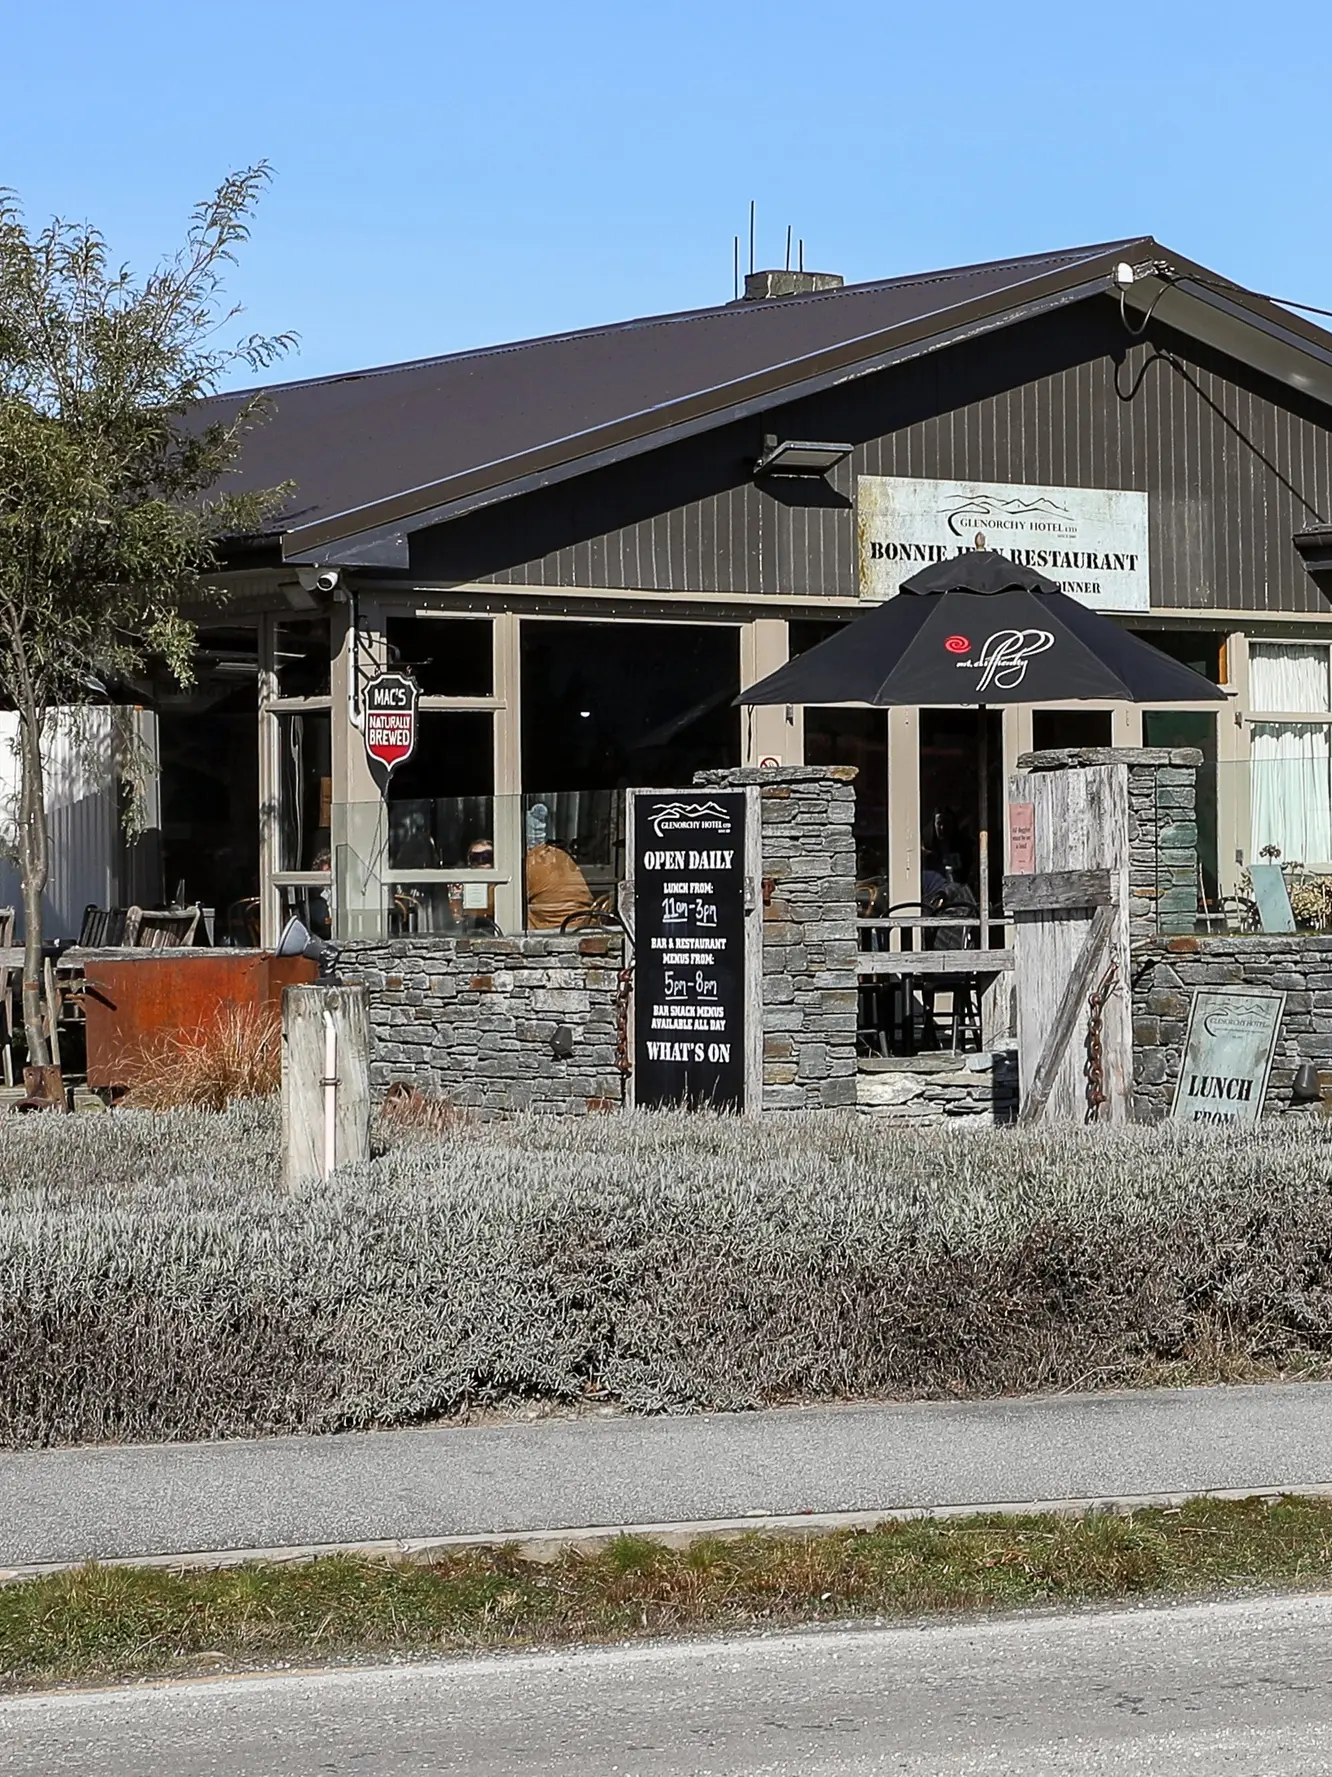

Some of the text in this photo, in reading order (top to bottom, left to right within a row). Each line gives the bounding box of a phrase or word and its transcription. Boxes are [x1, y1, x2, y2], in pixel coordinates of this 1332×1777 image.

[960, 517, 1026, 531] GLENORCHY
[1029, 521, 1065, 533] HOTEL
[870, 540, 948, 563] BONNIE
[1010, 547, 1139, 572] RESTAURANT
[373, 688, 407, 706] MAC'S
[369, 715, 411, 729] NATURALLY
[369, 728, 410, 746] BREWED
[660, 821, 701, 830] GLENORCHY
[701, 821, 723, 830] HOTEL
[643, 850, 734, 870] OPEN DAILY
[663, 882, 714, 894] LUNCH FROM:
[651, 937, 727, 950] BAR & RESTAURANT
[662, 953, 715, 965] MENUS FROM:
[653, 1005, 725, 1018] BAR SNACK MENUS
[651, 1017, 726, 1031] AVAILABLE ALL DAY
[646, 1041, 731, 1063] WHAT'S ON
[1187, 1075, 1254, 1101] LUNCH
